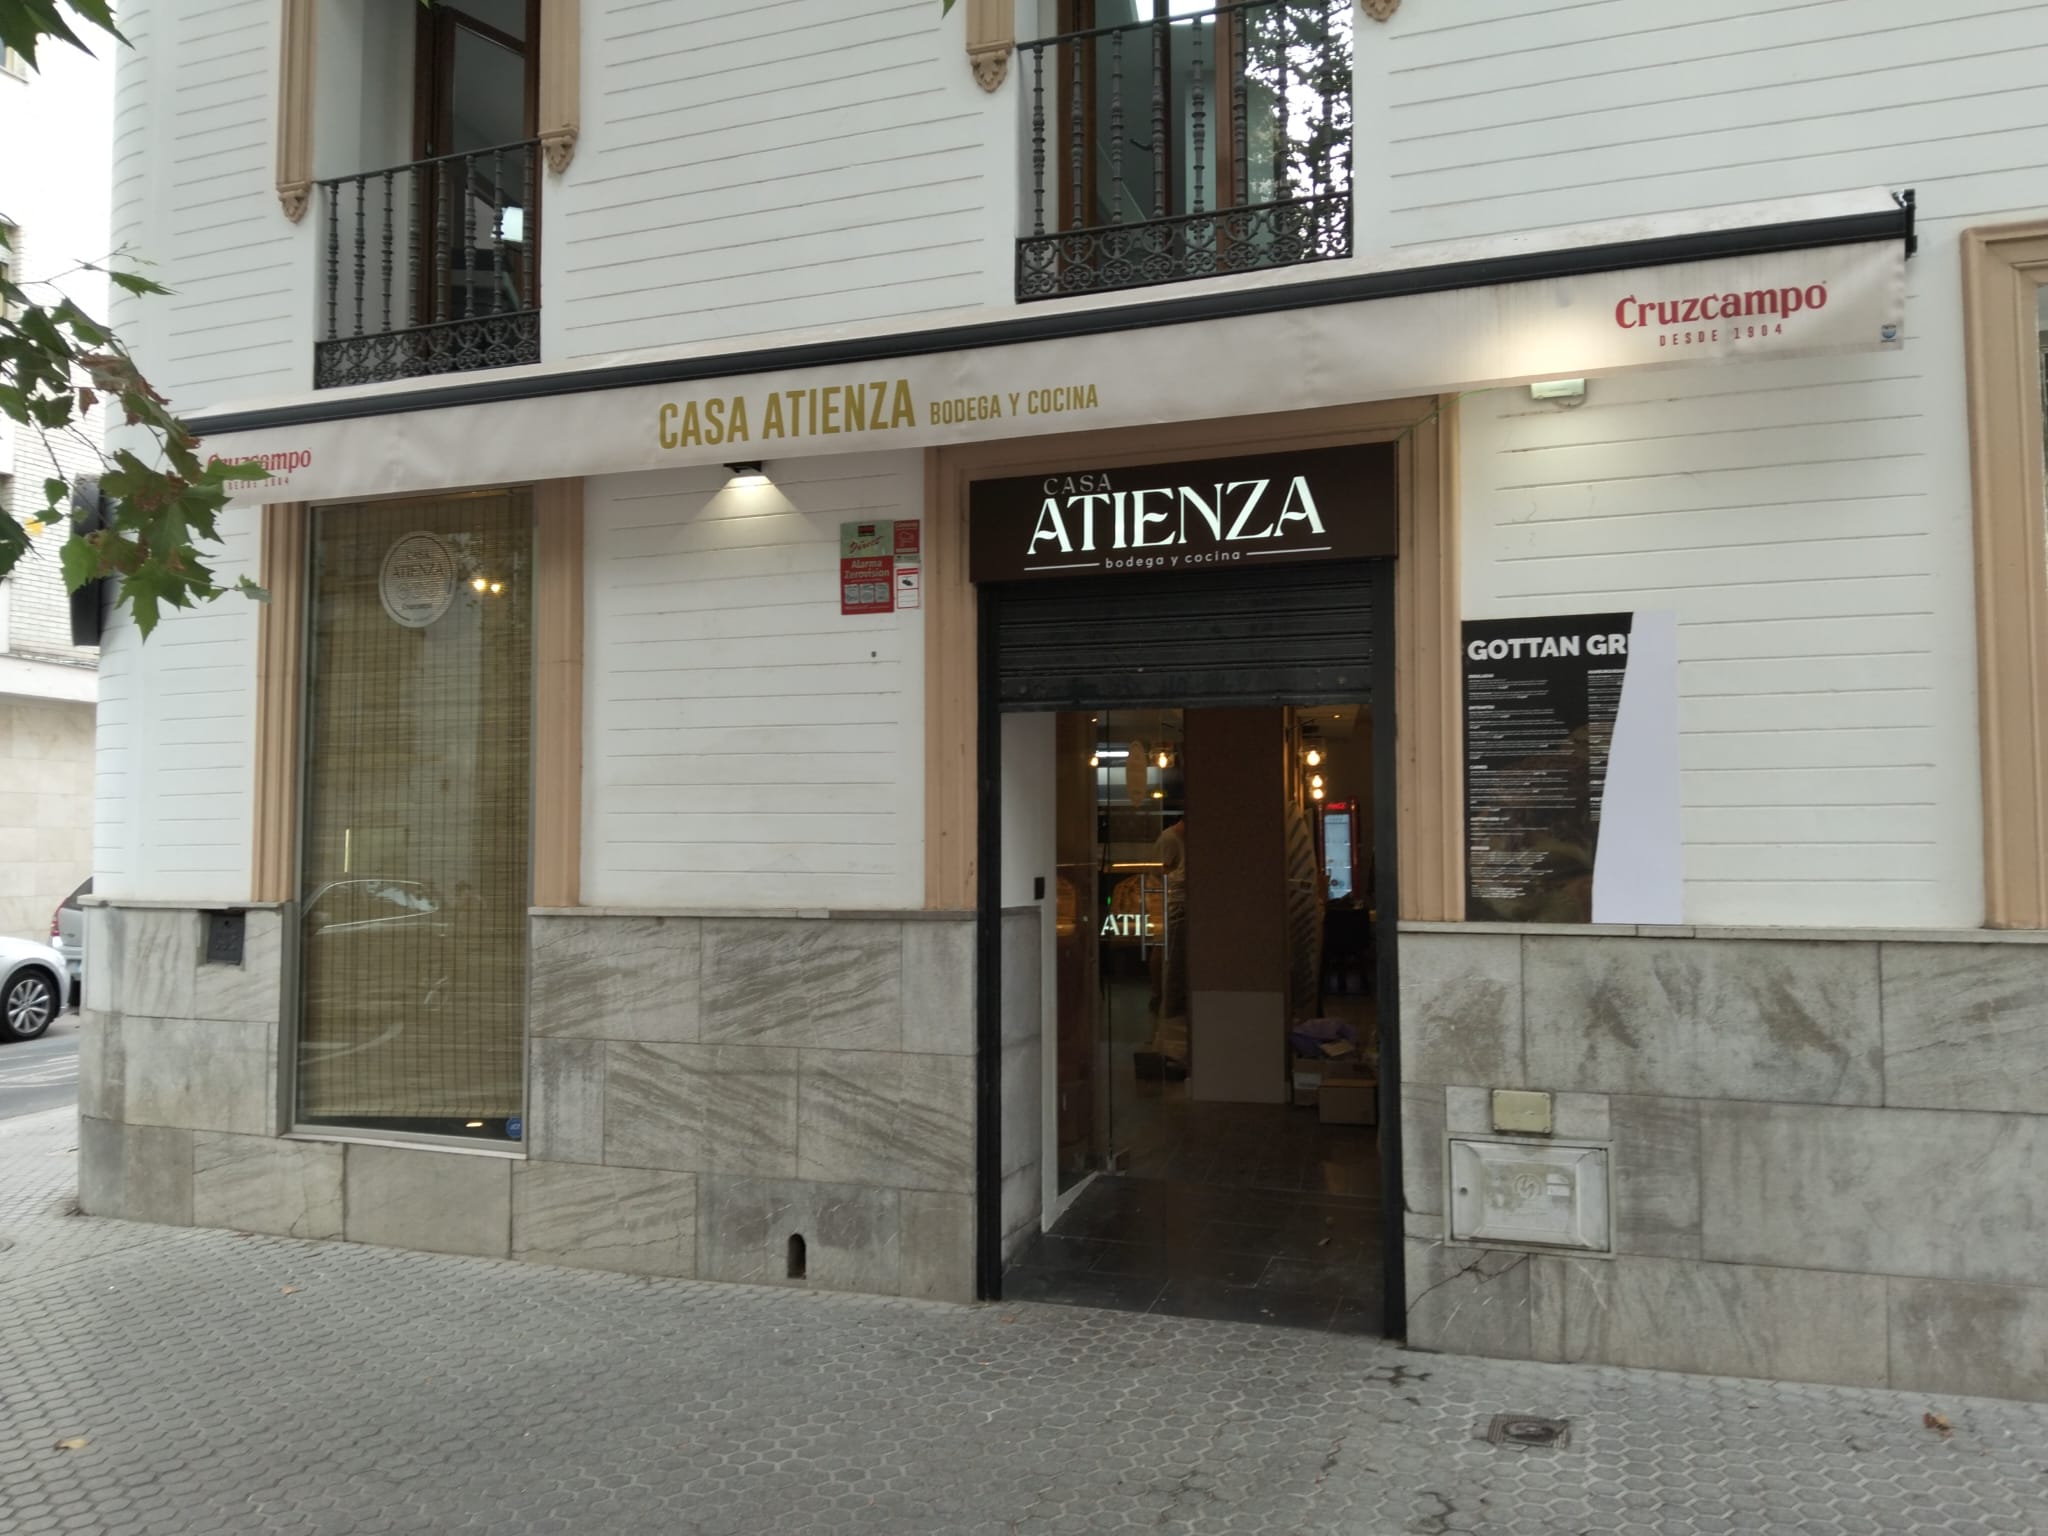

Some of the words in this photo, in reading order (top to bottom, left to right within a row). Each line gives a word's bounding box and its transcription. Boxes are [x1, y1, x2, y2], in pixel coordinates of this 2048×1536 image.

[1615, 283, 1828, 329] Cruzcampo
[1659, 330, 1718, 347] DESDE
[1734, 323, 1783, 339] 1904
[659, 396, 750, 450] CASA
[762, 379, 916, 440] ATIENZA
[930, 394, 1002, 426] BODEGA
[1008, 392, 1021, 416] Y
[1028, 383, 1099, 414] COCINA
[1043, 473, 1112, 495] CASA
[1027, 476, 1326, 555] ATIENZA
[1105, 556, 1164, 569] bodega
[1171, 555, 1179, 566] y
[1185, 551, 1241, 564] cocina
[1467, 635, 1580, 660] GOTTAN
